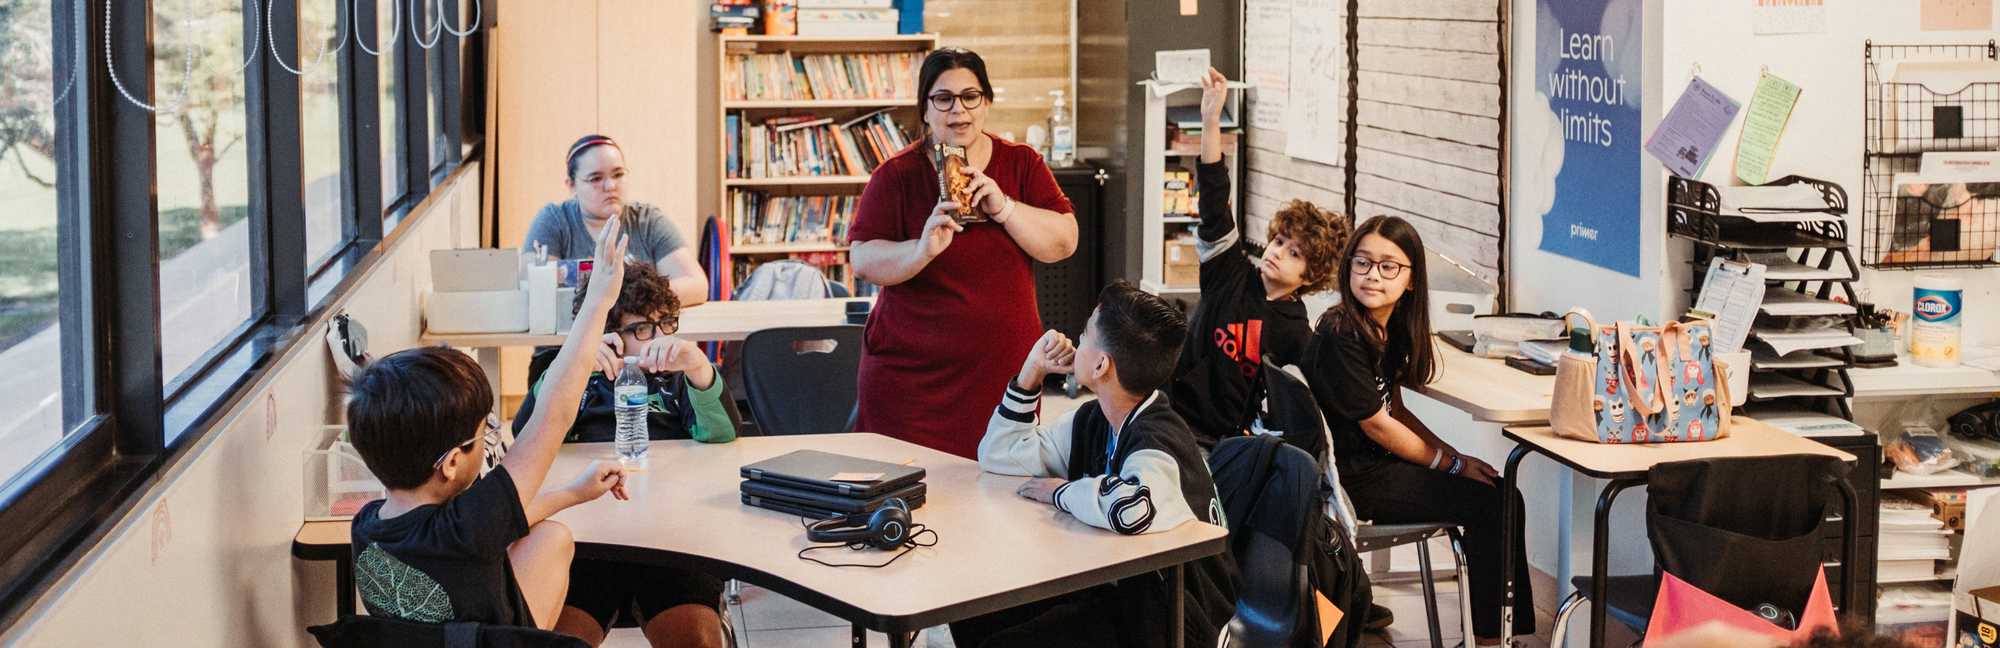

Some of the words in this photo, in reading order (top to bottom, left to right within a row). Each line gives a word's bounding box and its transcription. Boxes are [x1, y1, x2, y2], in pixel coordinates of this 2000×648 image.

[1560, 27, 1614, 62] Learn
[1548, 67, 1627, 106] without
[1560, 107, 1613, 147] limits
[1571, 221, 1598, 240] primer
[1917, 302, 1946, 314] CLOROX
